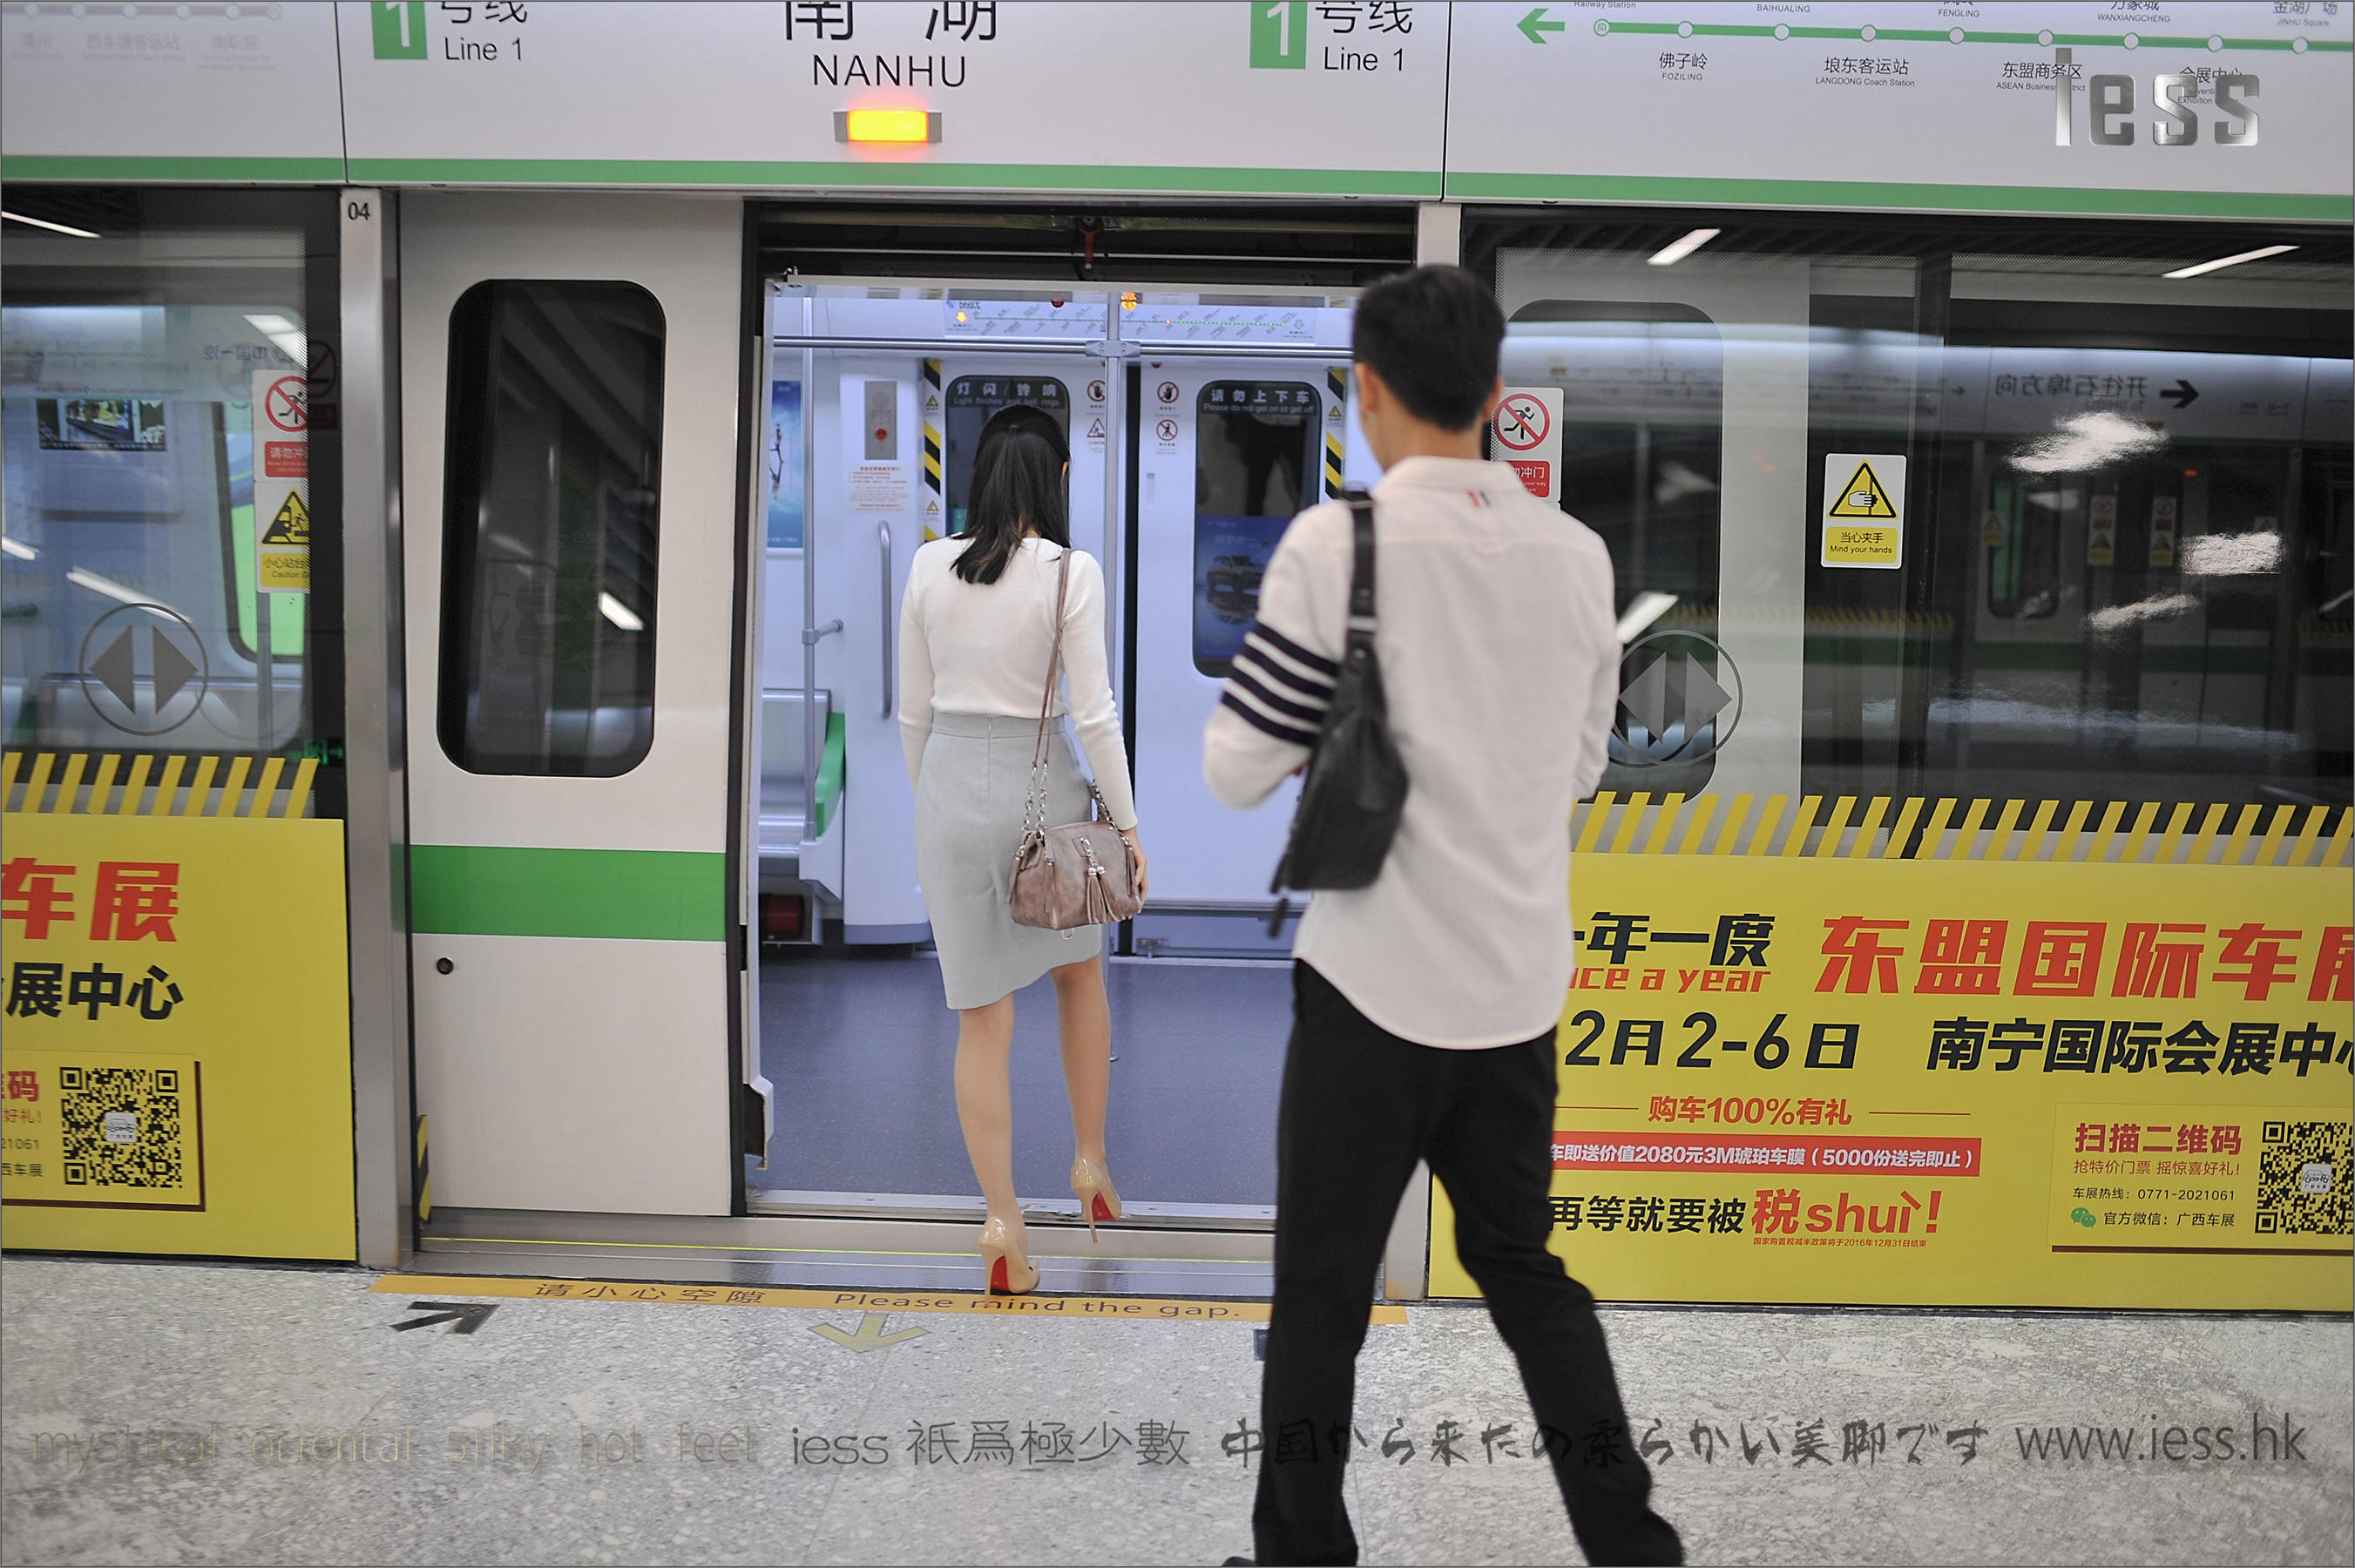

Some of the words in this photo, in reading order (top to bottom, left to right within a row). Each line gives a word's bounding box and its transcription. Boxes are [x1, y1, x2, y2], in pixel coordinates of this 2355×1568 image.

[1756, 3, 1810, 13] BAIHUALING
[1938, 9, 1979, 17] FENGLING
[2097, 13, 2170, 23] WANXIANGCHENG
[1267, 2, 1289, 56] 1
[445, 37, 497, 60] Line
[511, 37, 522, 60] 1
[1324, 46, 1378, 71] Line
[1394, 48, 1403, 71] 1
[813, 55, 965, 87] NANHU
[1659, 52, 1709, 71] 佛子岭
[1824, 57, 1910, 76] 埌东客运站
[2002, 62, 2083, 79] 东盟商务区
[1661, 72, 1703, 81] FOZILING
[1815, 76, 1863, 86] LANGDONG
[1864, 77, 1888, 86] Coach
[1889, 78, 1916, 87] Station
[349, 201, 371, 220] 04
[1830, 544, 1849, 553] Mind
[1851, 545, 1867, 555] your
[1869, 545, 1893, 554] hands
[1840, 532, 1884, 544] 当心夹手
[1, 857, 179, 942] 车展
[1573, 911, 1776, 967] 年一度
[2, 962, 184, 1021] 展中心
[1640, 969, 1666, 990] a
[1677, 969, 1771, 993] year
[2, 1071, 39, 1102] 码
[1648, 1095, 1852, 1125] 购车100%有礼
[2074, 1122, 2242, 1156] 扫描二维码
[2074, 1159, 2151, 1175] 抢特价门票
[534, 1282, 767, 1305] 请小心空隙
[834, 1293, 954, 1308] Please
[970, 1299, 1066, 1313] mind
[1082, 1301, 1148, 1315] the
[1159, 1304, 1242, 1319] gap.
